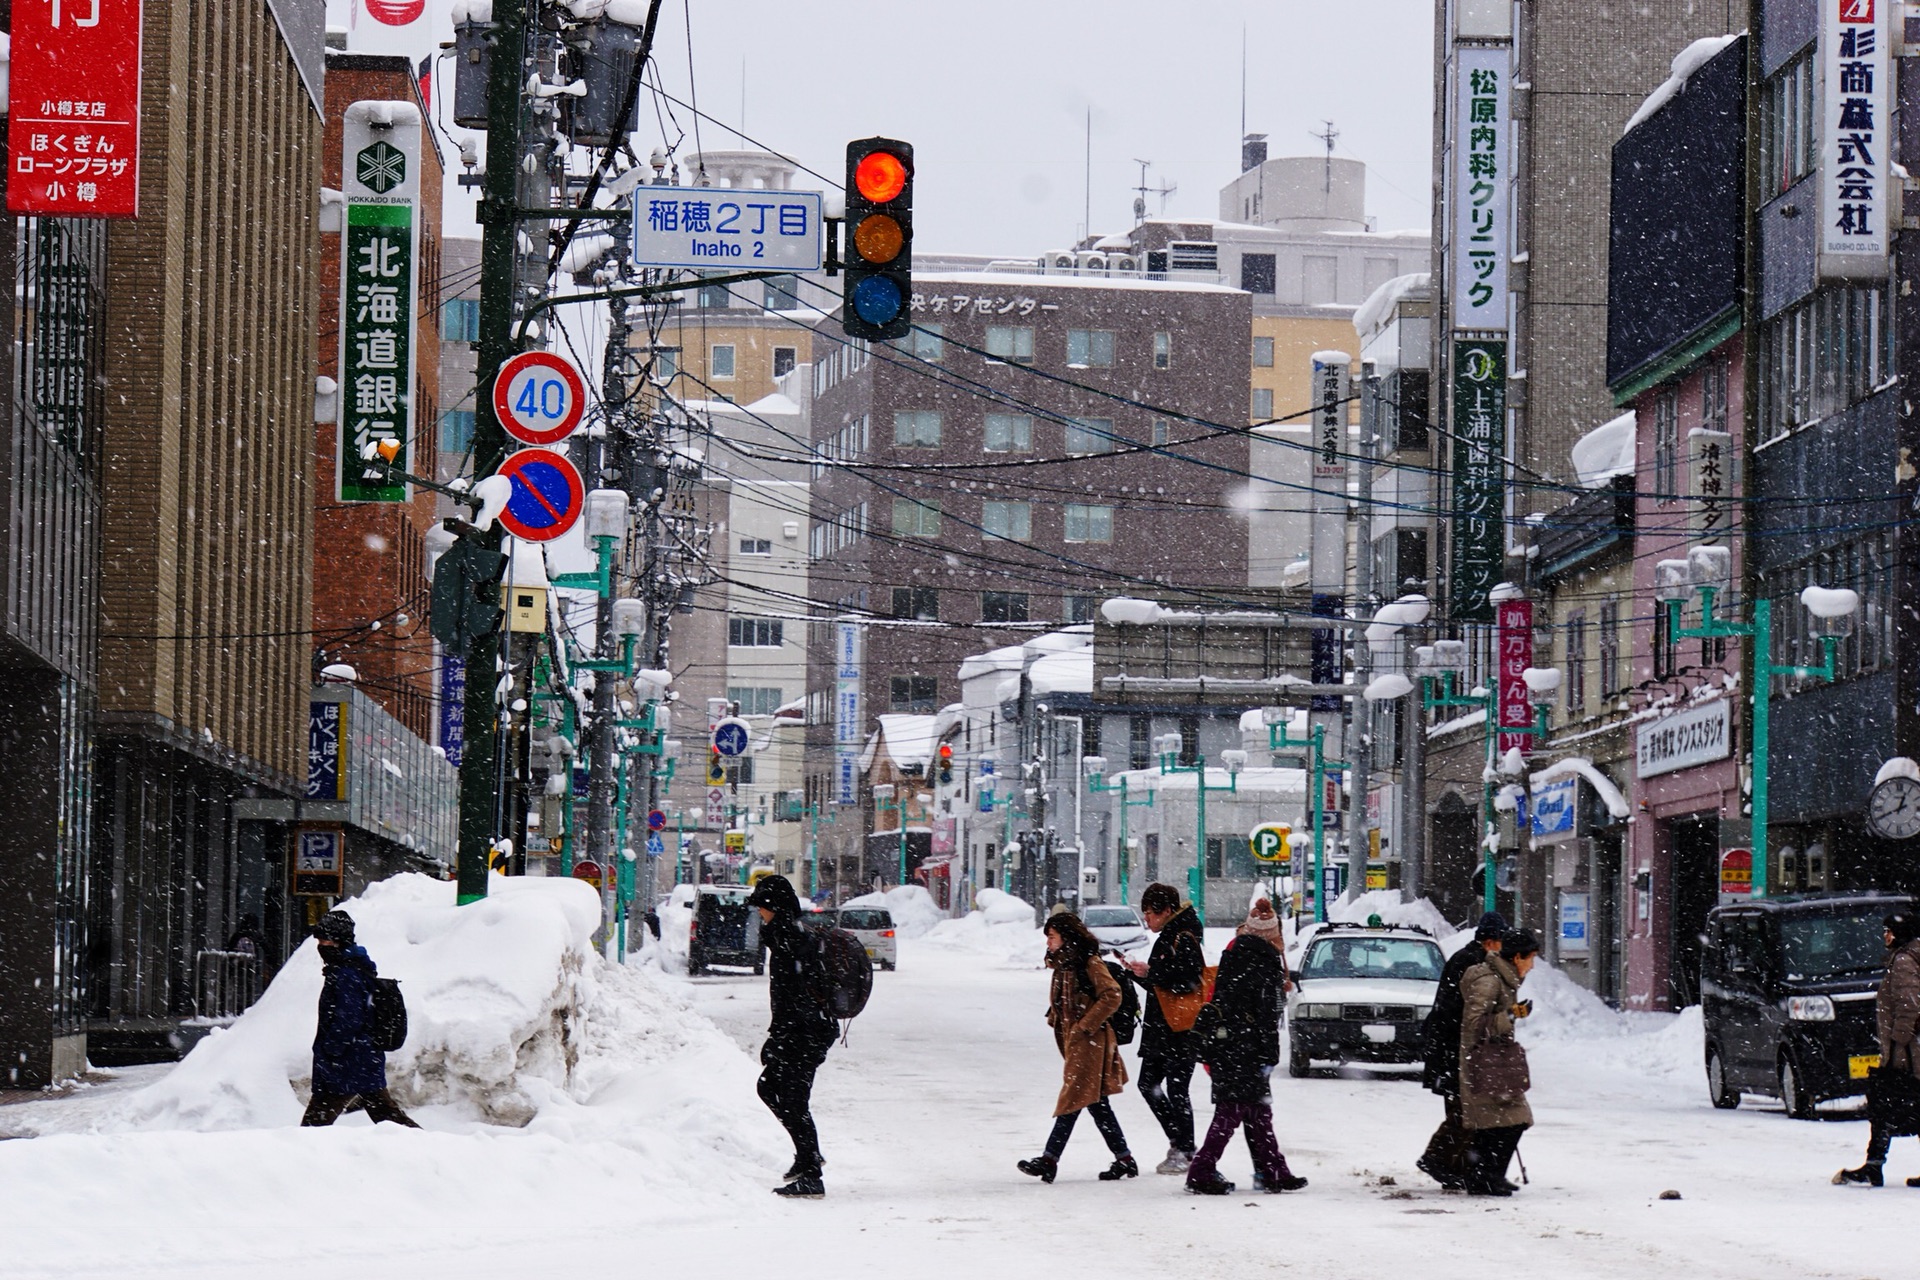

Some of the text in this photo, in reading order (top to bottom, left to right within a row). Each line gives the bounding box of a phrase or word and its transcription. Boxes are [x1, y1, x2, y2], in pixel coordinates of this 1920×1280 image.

[41, 101, 106, 117] 小樽支店
[1835, 27, 1875, 236] 杉商株式会社
[31, 134, 115, 154] ほくぎん
[17, 157, 128, 176] ローンプラザ
[45, 181, 97, 201] 小樽
[1468, 68, 1498, 308] 松原内科クリニック
[348, 196, 389, 204] HOKKAIDO
[648, 200, 807, 236] 稲穂2丁目
[692, 239, 764, 257] Inaho 2
[354, 237, 401, 459] 北海道銀行
[516, 378, 565, 419] 40
[1507, 611, 1526, 747] 処方せん受付
[1261, 833, 1278, 855] P
[304, 859, 332, 870] 入口
